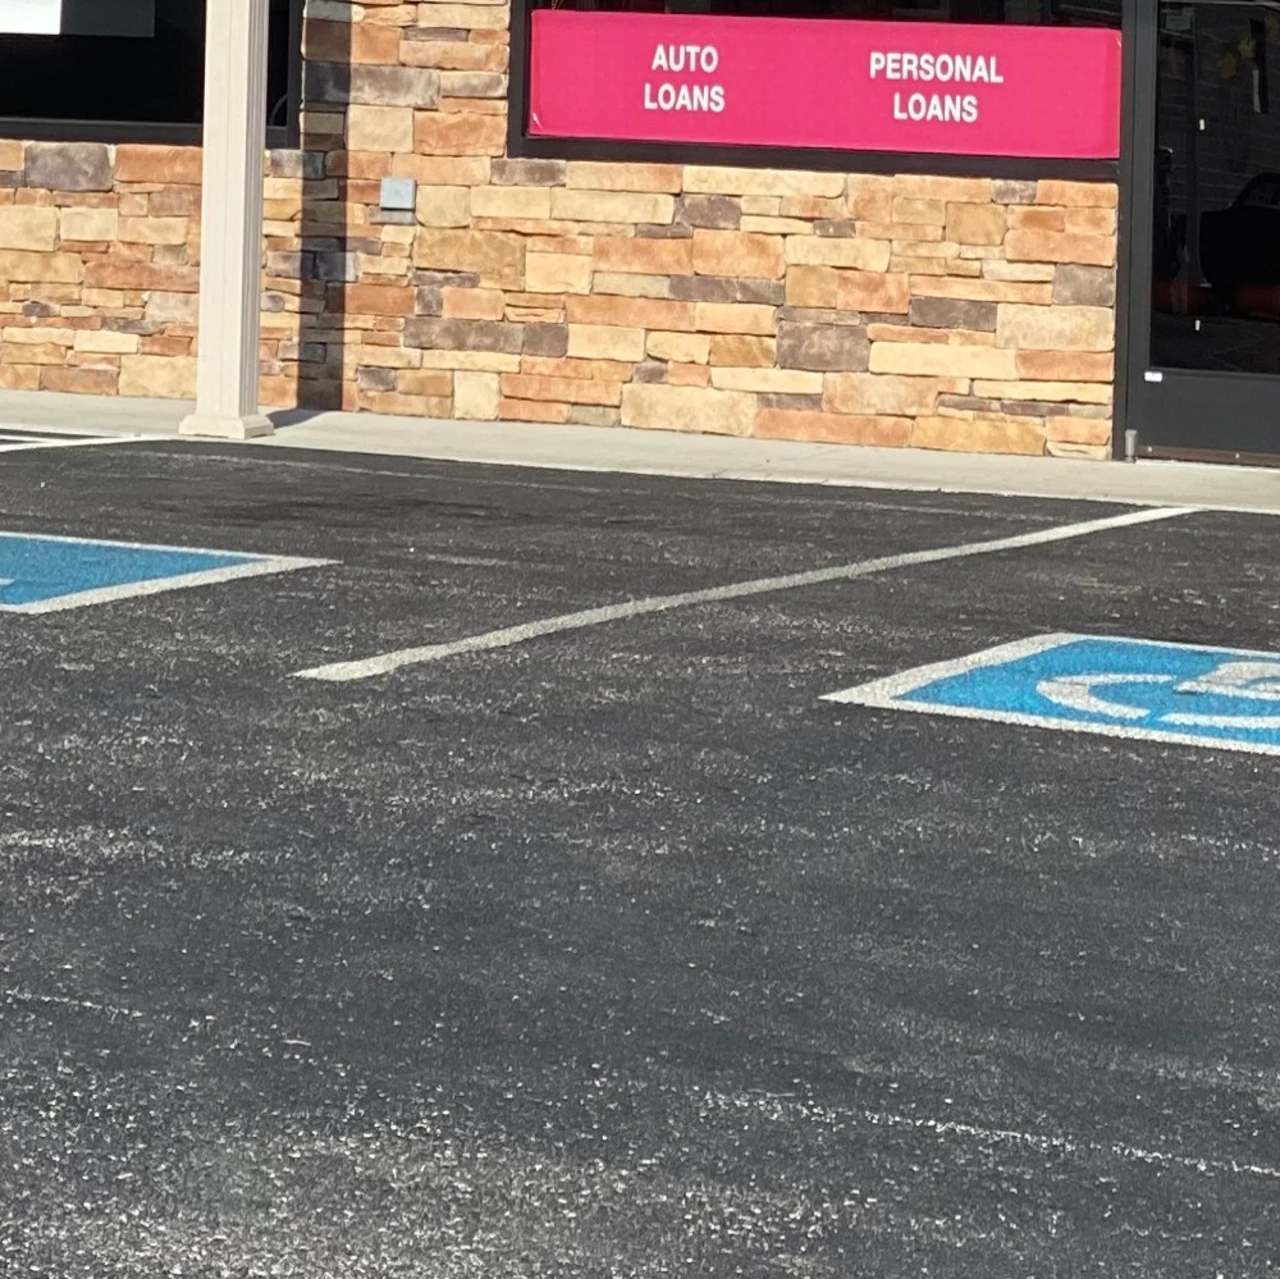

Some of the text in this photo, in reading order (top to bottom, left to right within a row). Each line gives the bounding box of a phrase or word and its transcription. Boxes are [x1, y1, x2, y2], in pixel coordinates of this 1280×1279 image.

[651, 44, 719, 73] AUTO
[869, 51, 1004, 84] PERSONAL
[644, 83, 725, 113] LOANS
[892, 92, 978, 122] LOANS
